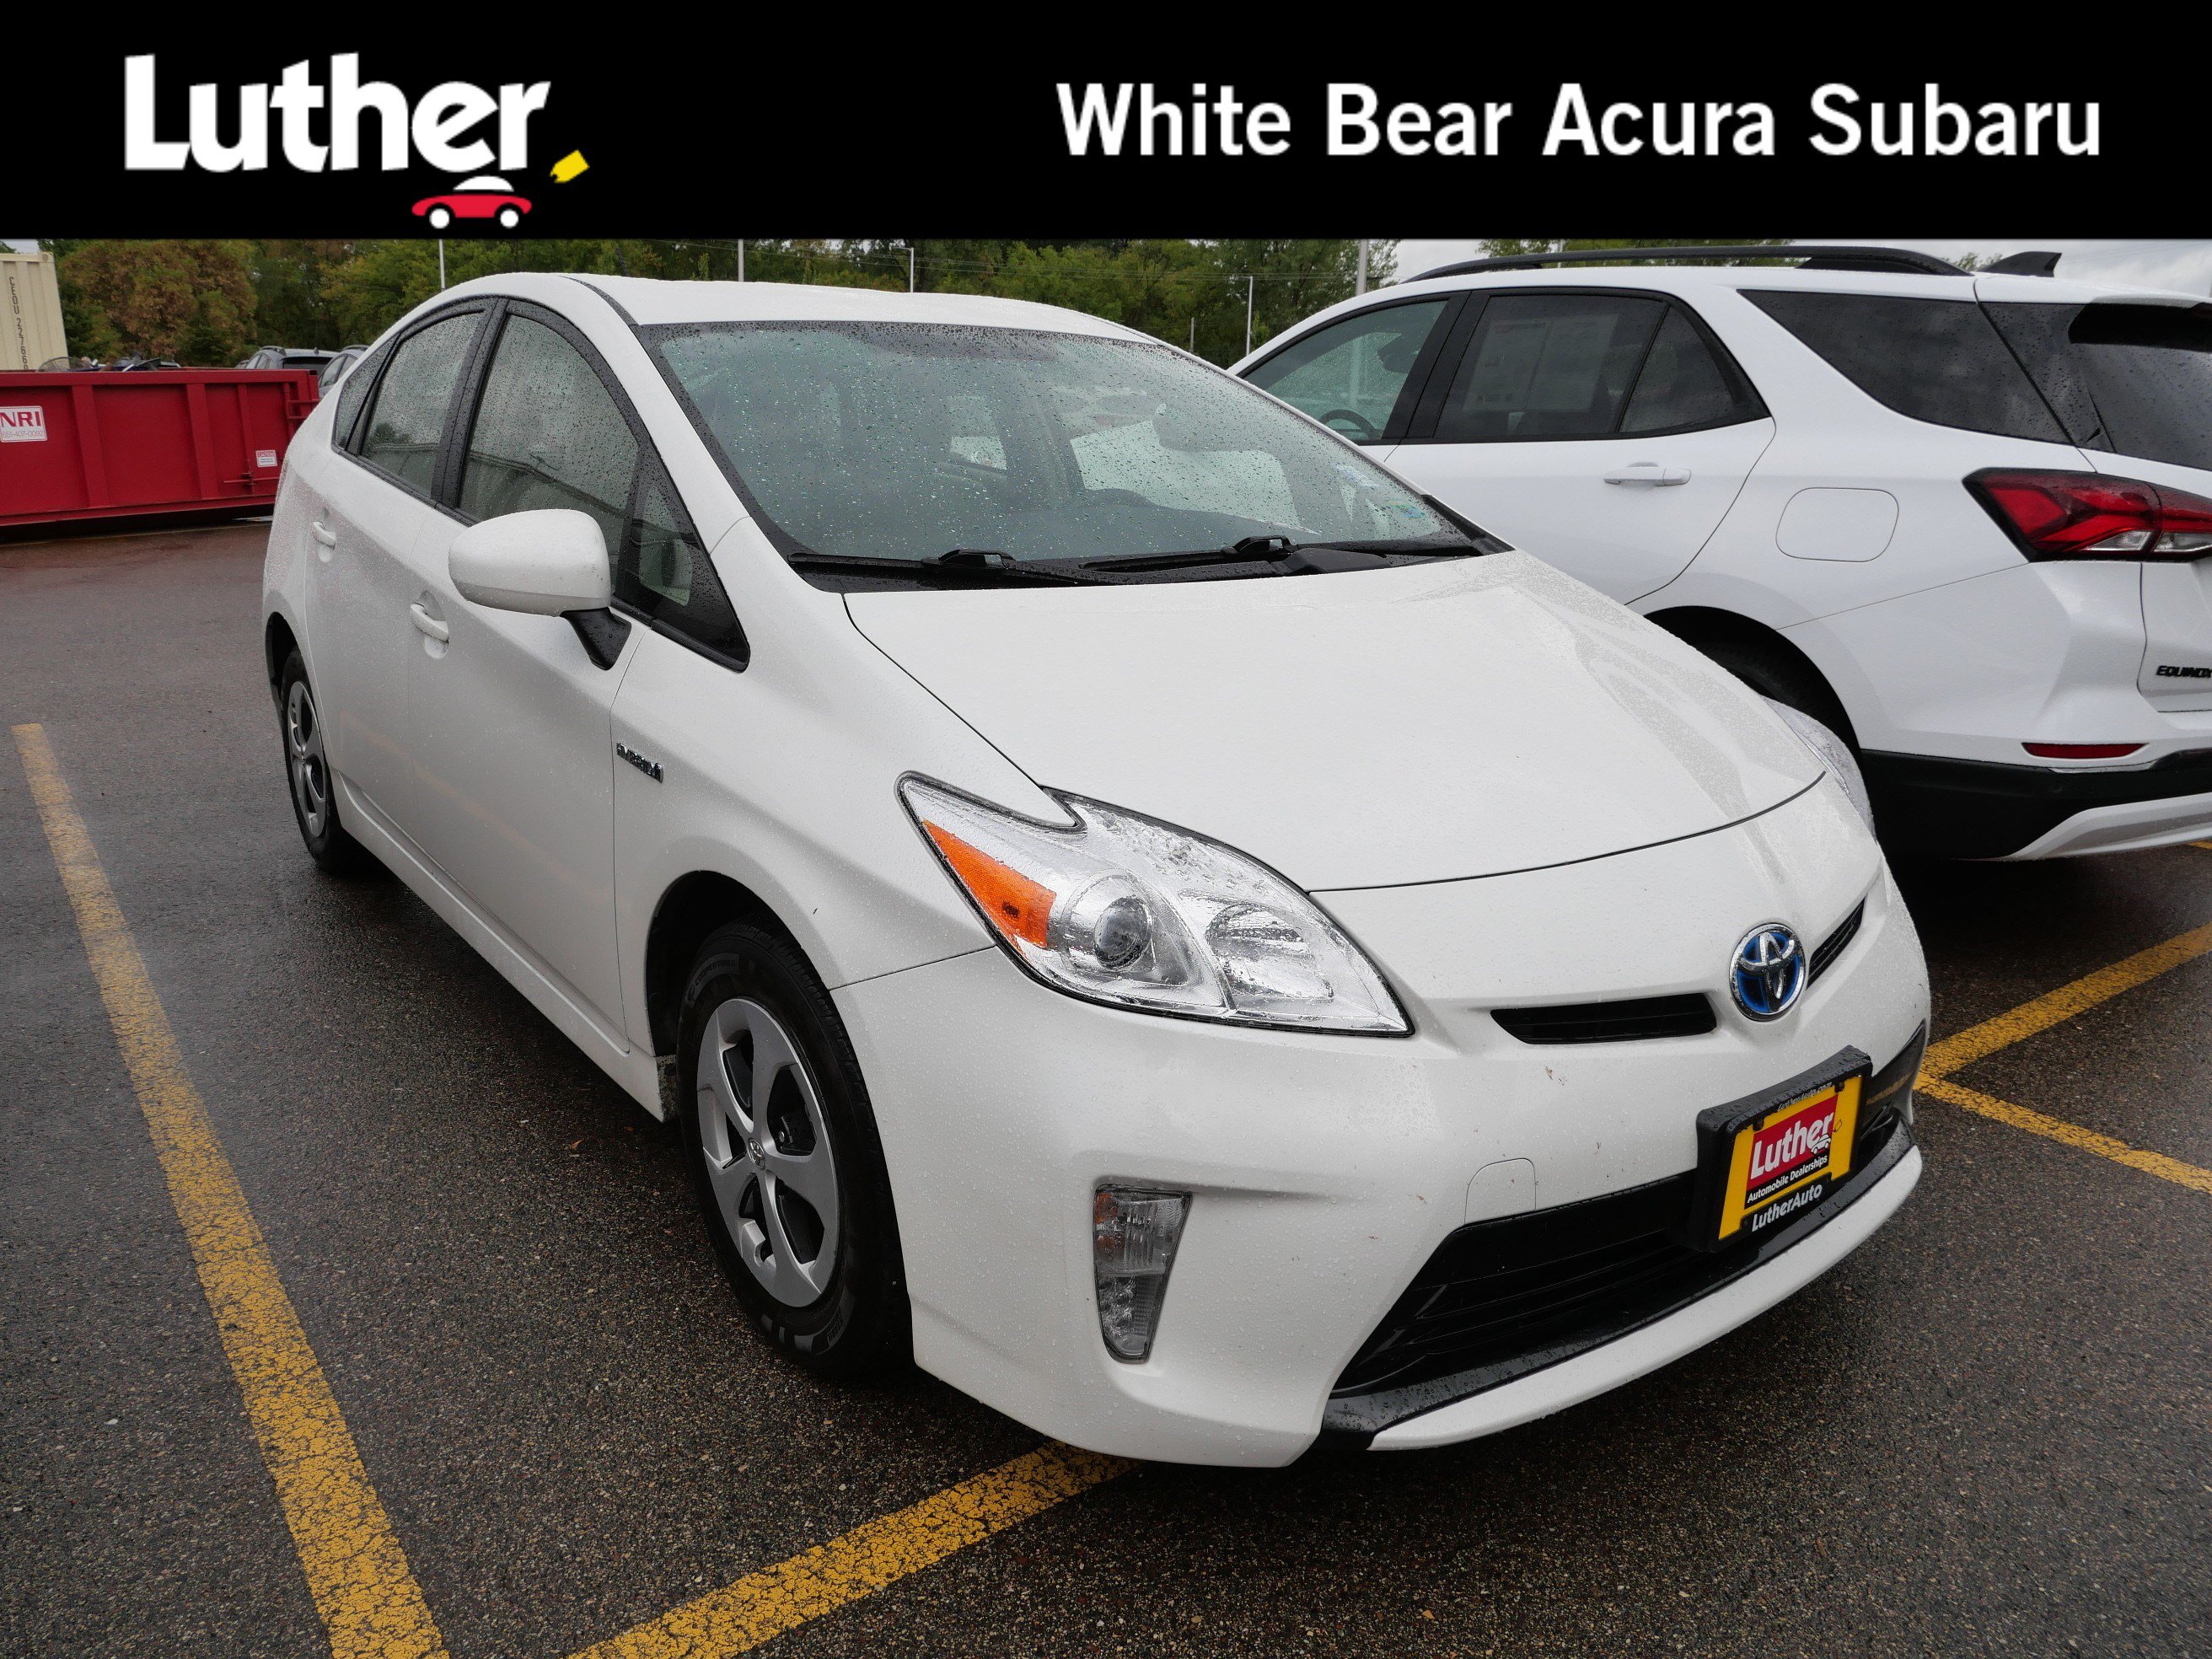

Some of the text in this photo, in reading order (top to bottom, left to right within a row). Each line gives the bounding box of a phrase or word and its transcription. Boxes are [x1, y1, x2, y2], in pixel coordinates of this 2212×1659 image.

[1750, 1112, 1834, 1180] Luther
[1747, 1155, 1828, 1204] Automobile Dealerships
[1752, 1184, 1823, 1232] LutherAuto
